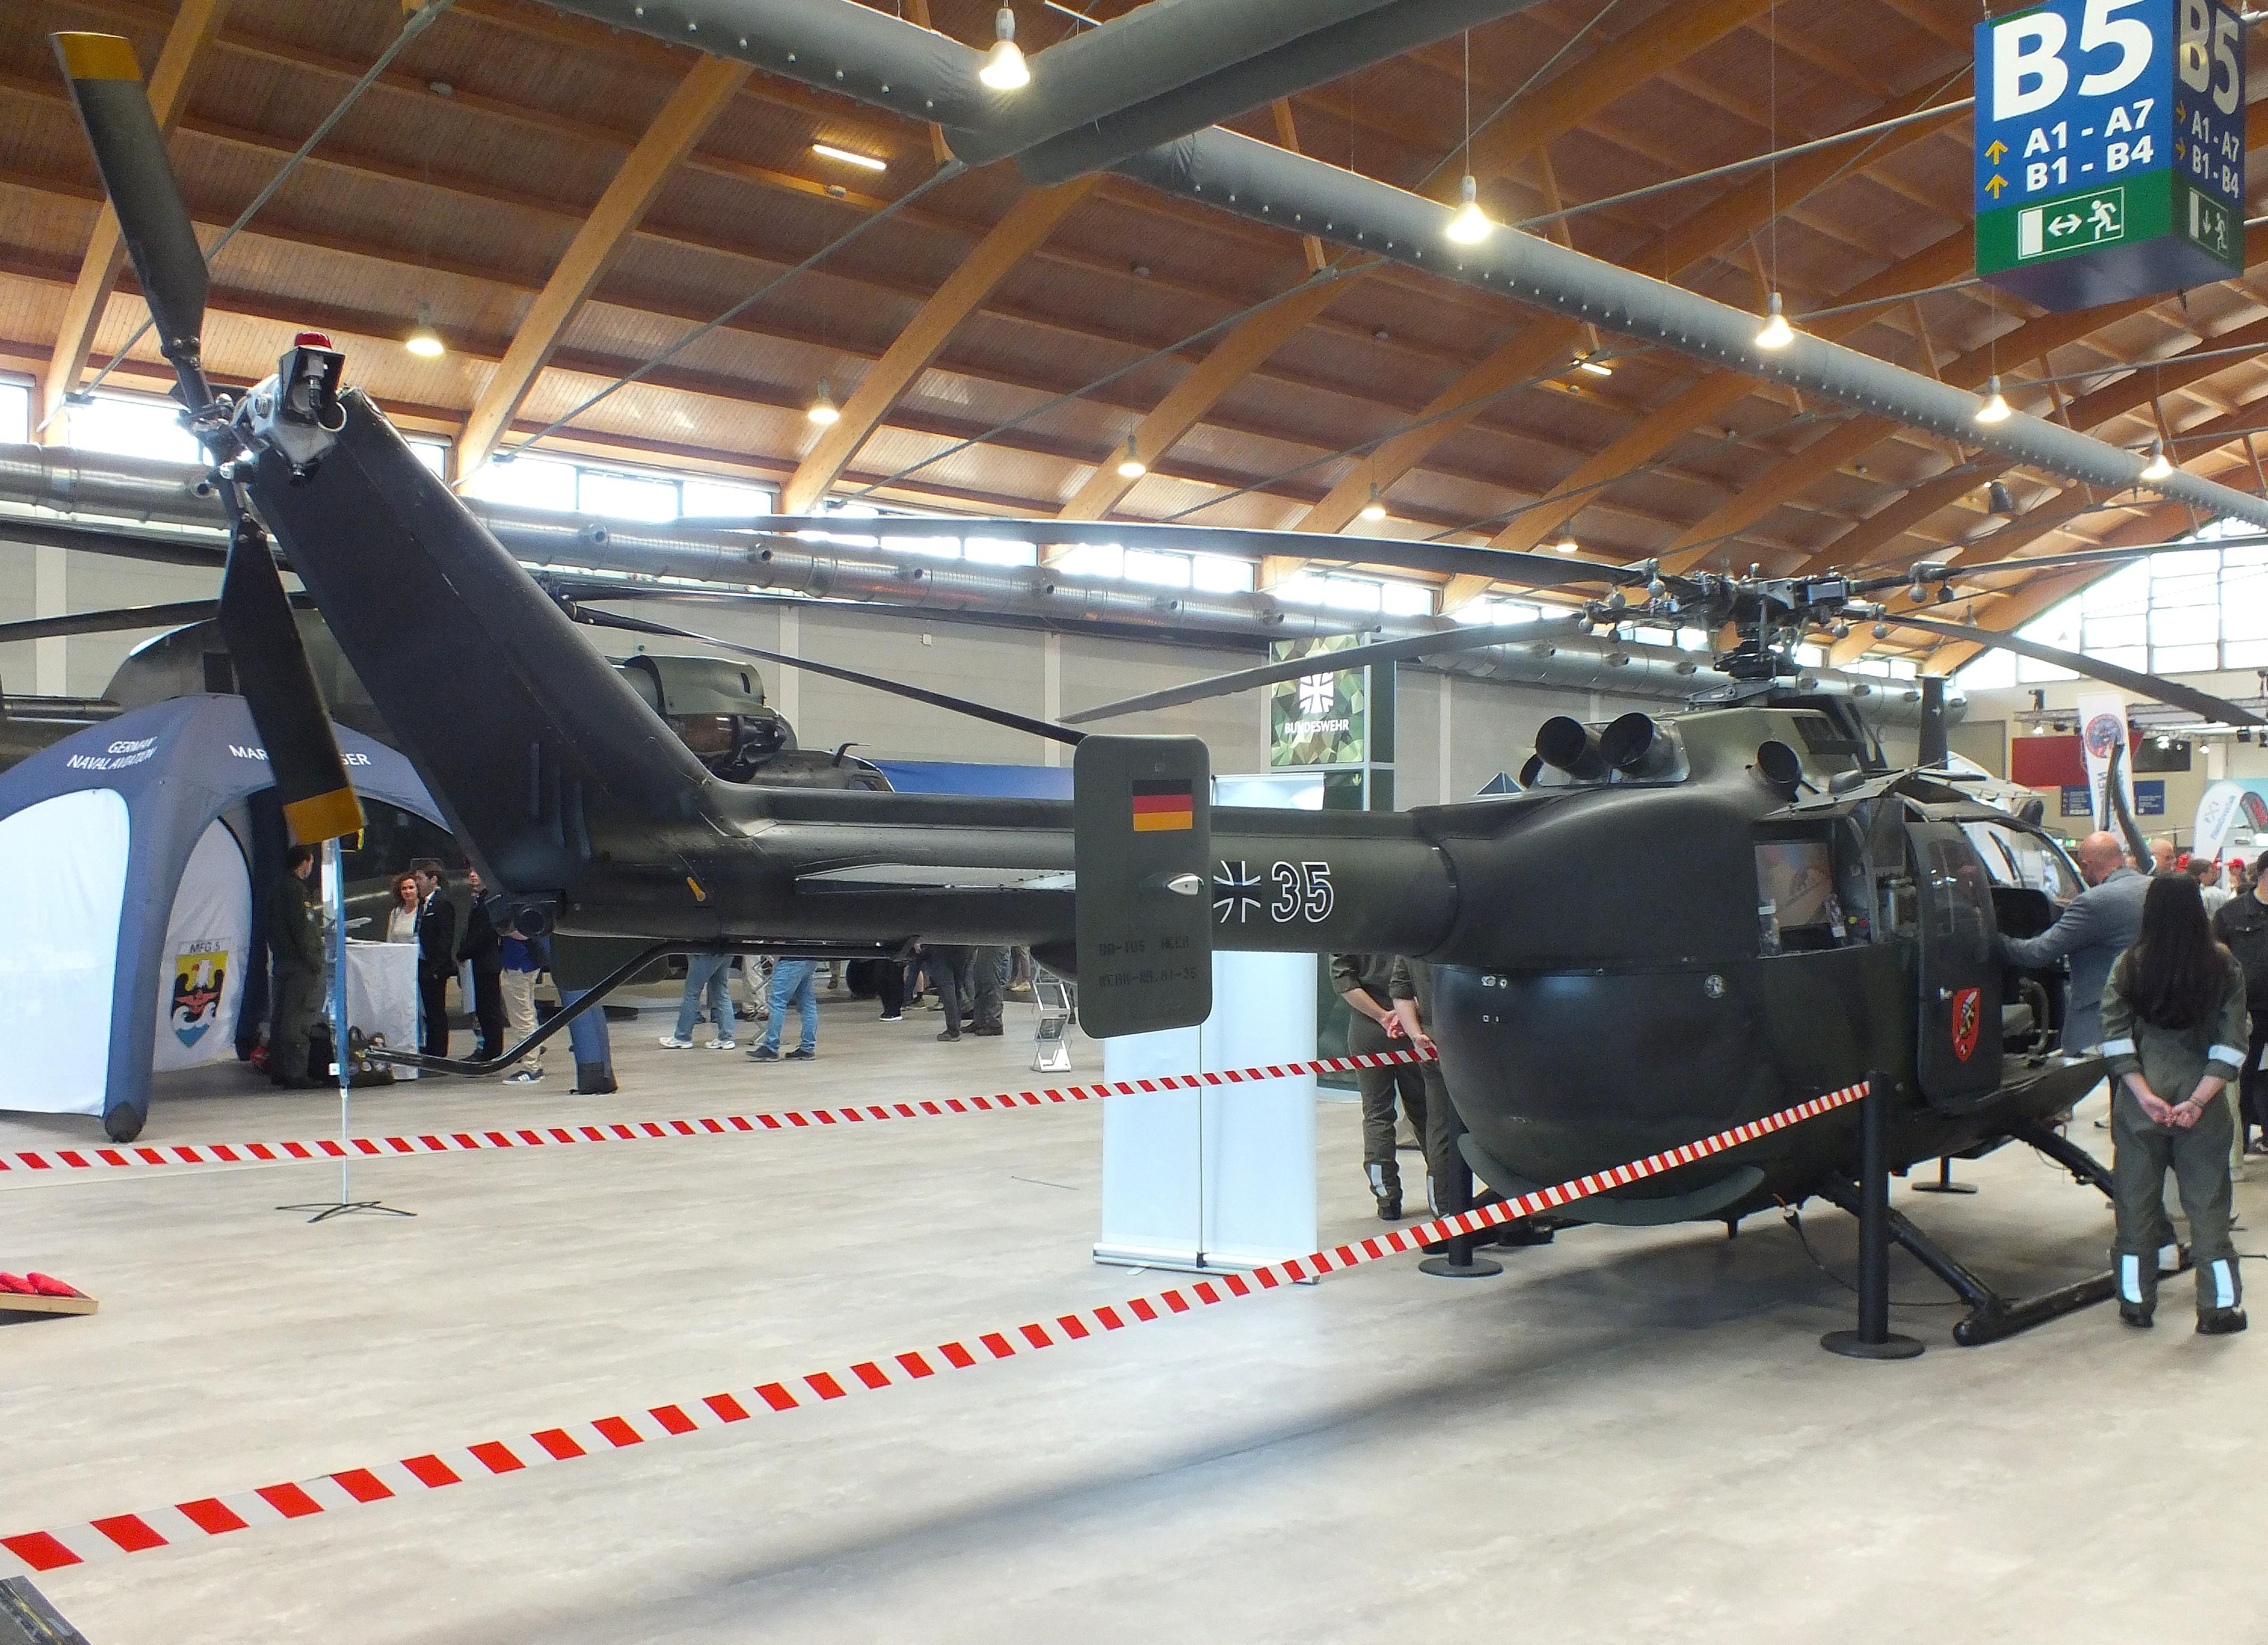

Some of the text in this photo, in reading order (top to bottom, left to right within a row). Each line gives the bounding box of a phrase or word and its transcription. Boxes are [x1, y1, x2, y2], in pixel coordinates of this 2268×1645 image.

[1993, 0, 2153, 122] B5
[2179, 0, 2239, 115] B5
[2023, 98, 2155, 159] A1 - A7
[2191, 110, 2209, 144] A1
[2221, 131, 2240, 163] A7
[2026, 135, 2154, 192] B1 - B4
[2192, 144, 2209, 180] B1
[2222, 164, 2239, 199] B4
[1285, 719, 1350, 734] BUNDESWEHR
[67, 754, 112, 770] NAVAL
[1271, 861, 1334, 923] 35
